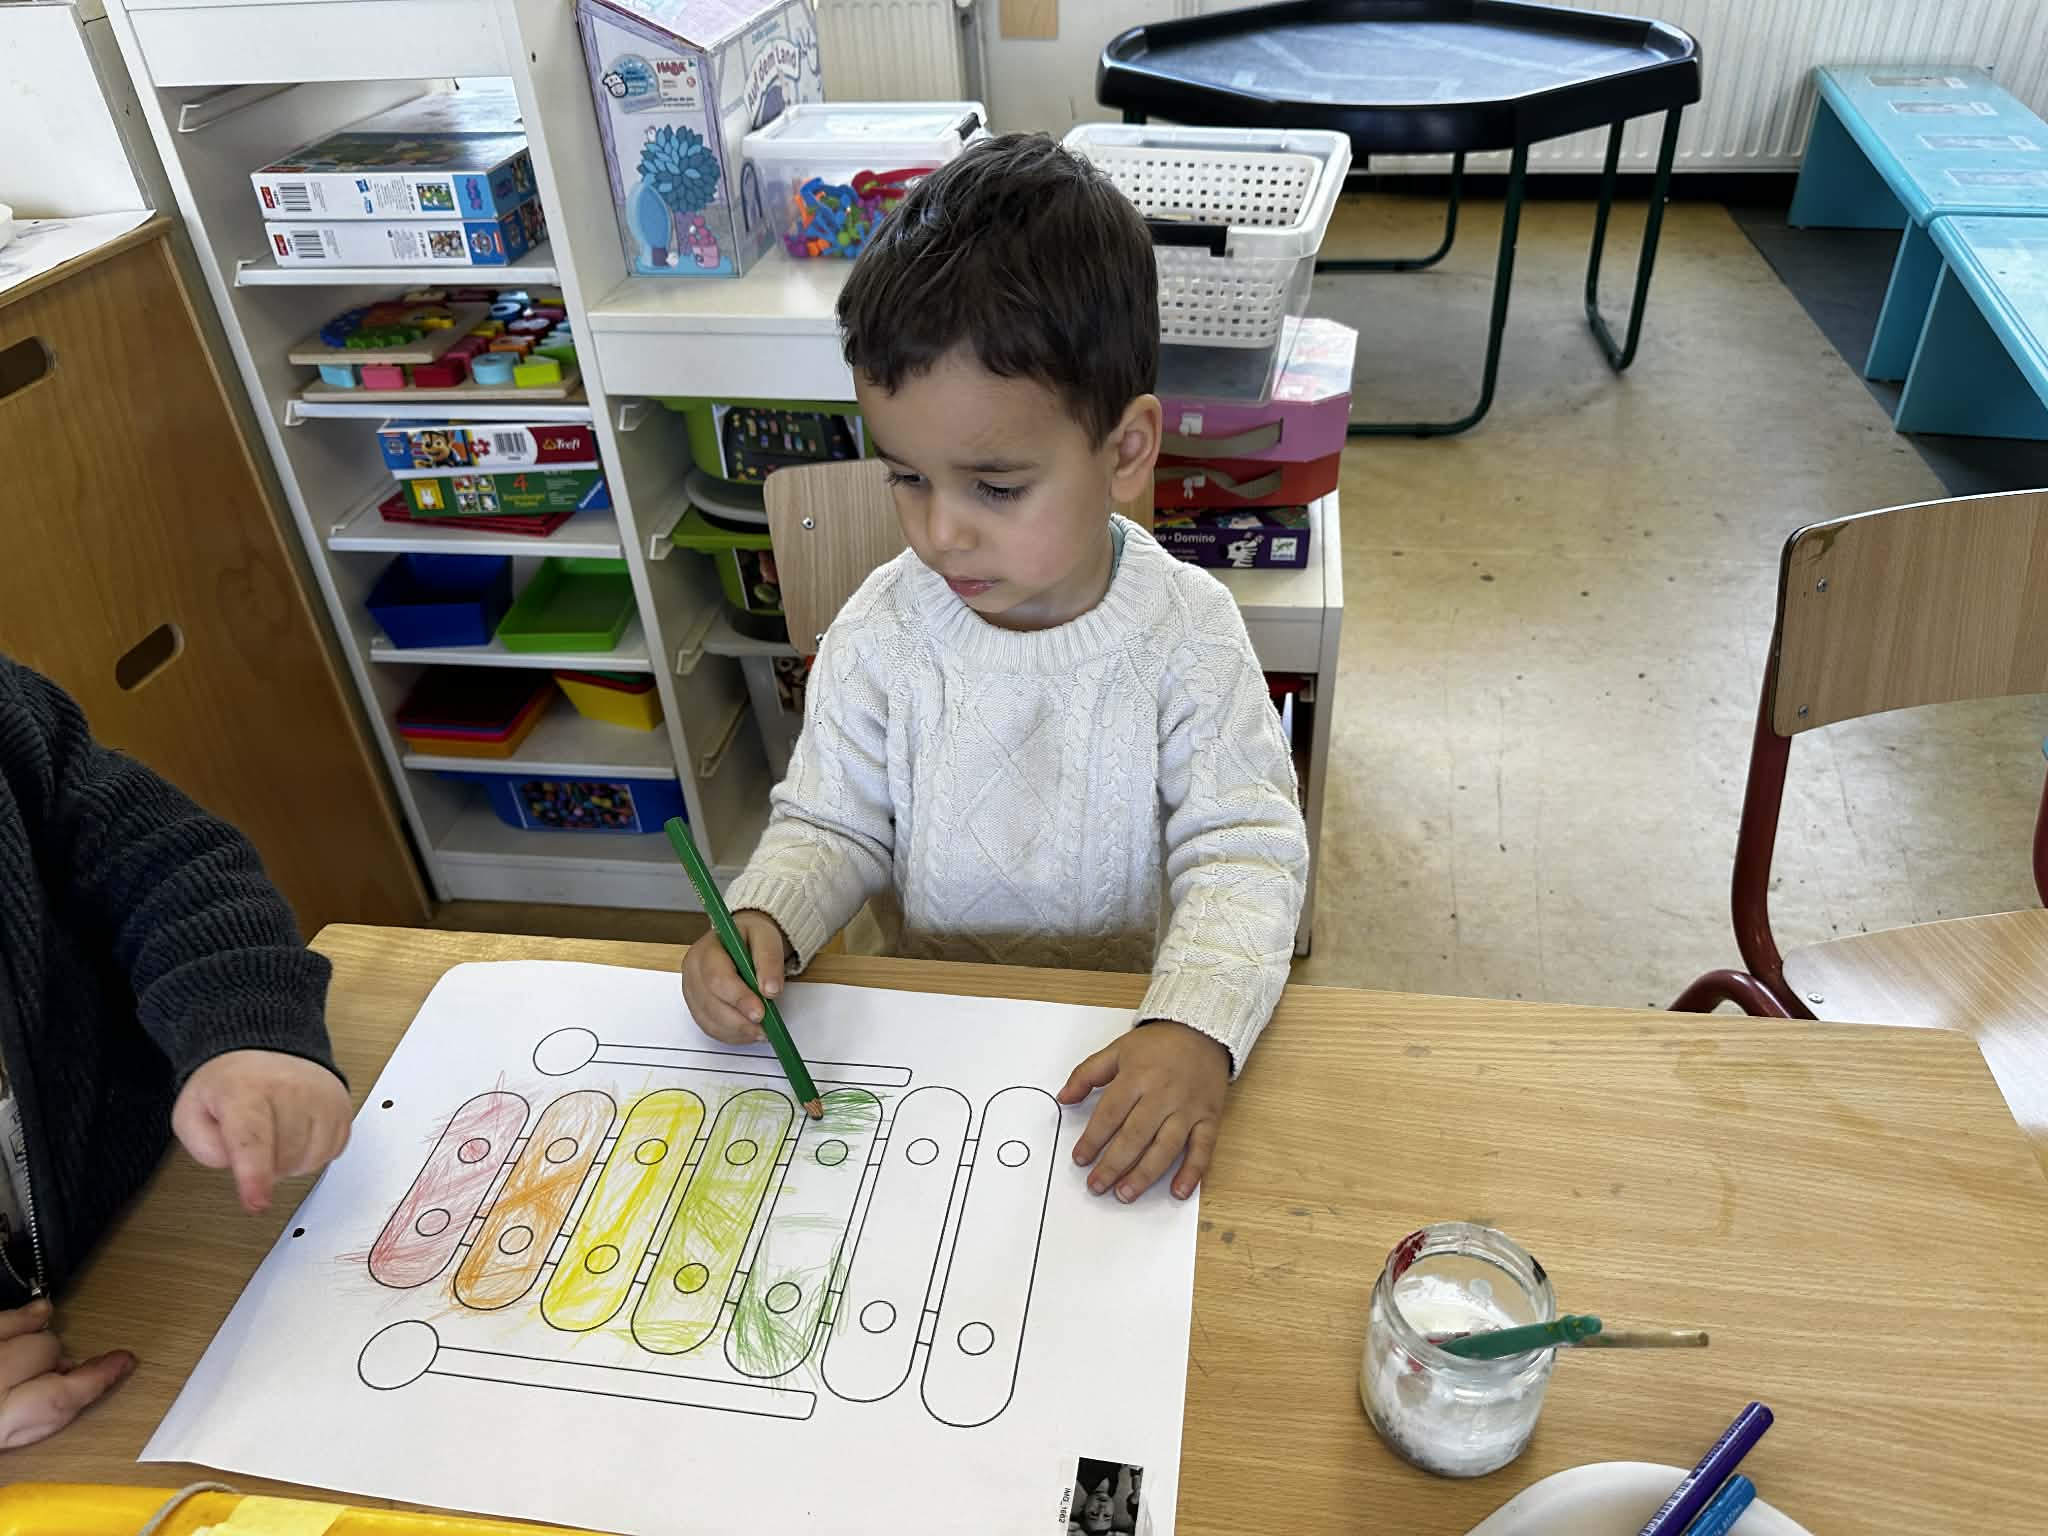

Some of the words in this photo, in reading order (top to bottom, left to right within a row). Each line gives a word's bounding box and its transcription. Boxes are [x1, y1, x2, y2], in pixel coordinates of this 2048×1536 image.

[775, 45, 797, 69] Land
[656, 61, 687, 76] HABA
[556, 438, 581, 452] Trefl
[513, 473, 528, 492] 4
[1174, 532, 1216, 543] Domino
